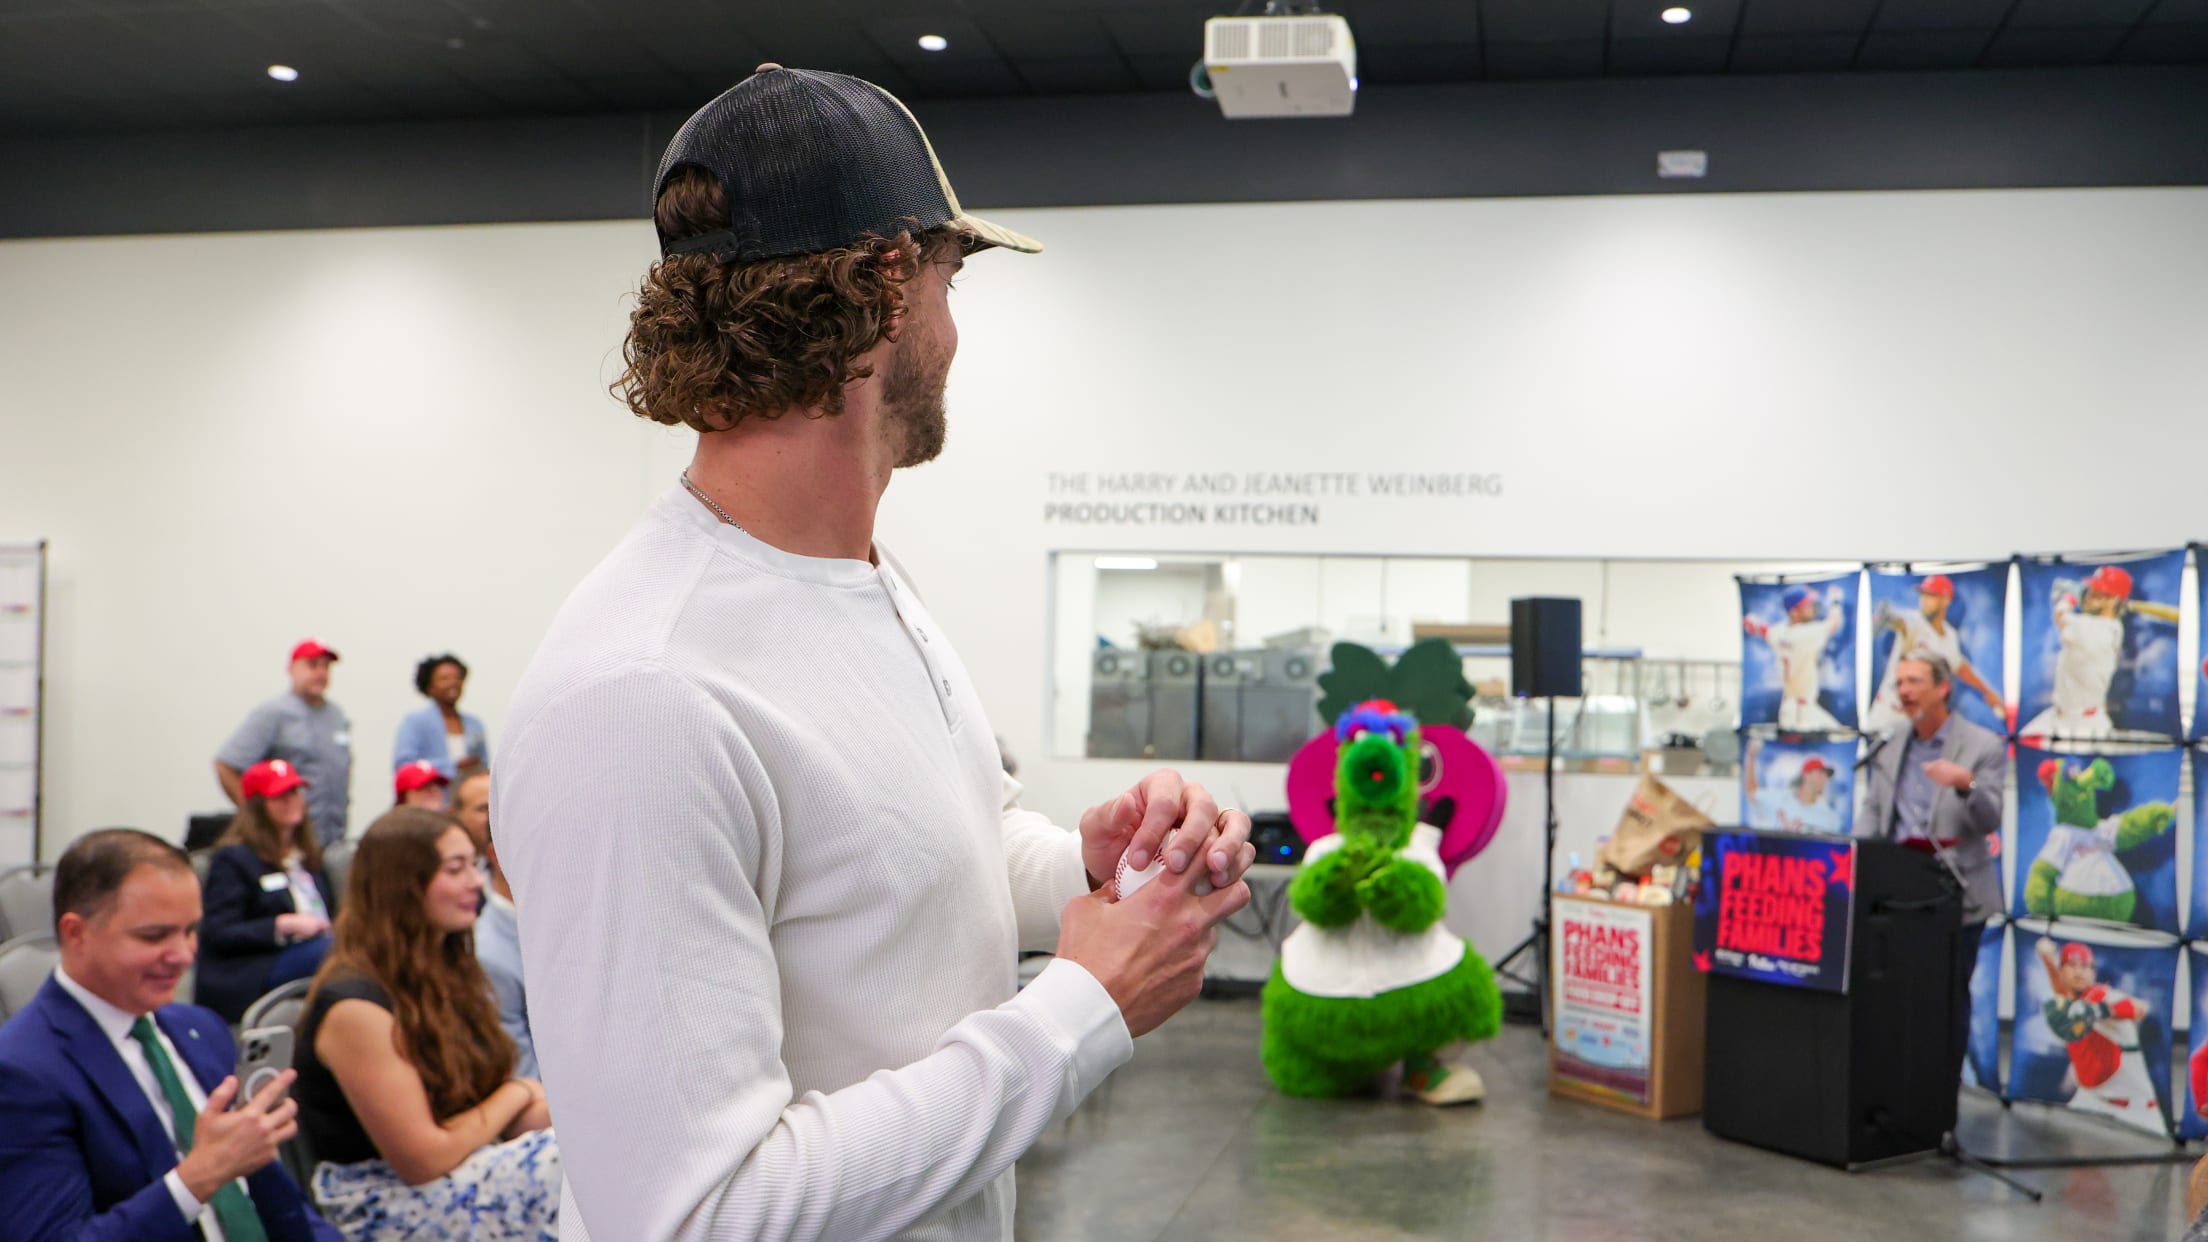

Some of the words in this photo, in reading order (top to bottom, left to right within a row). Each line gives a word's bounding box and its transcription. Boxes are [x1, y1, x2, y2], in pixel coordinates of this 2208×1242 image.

[1046, 472, 1089, 495] THE
[1097, 472, 1176, 495] HARRY
[1183, 472, 1237, 496] AND
[1243, 472, 1359, 496] JEANETTE
[1367, 472, 1503, 497] WEINBERG
[1044, 502, 1205, 525] PRODUCTION
[1213, 503, 1318, 526] KITCHEN
[1721, 850, 1827, 899] PHANS
[1719, 888, 1825, 931] FEEDING
[1564, 919, 1640, 957] PHANS
[1716, 918, 1823, 962] FAMILIES
